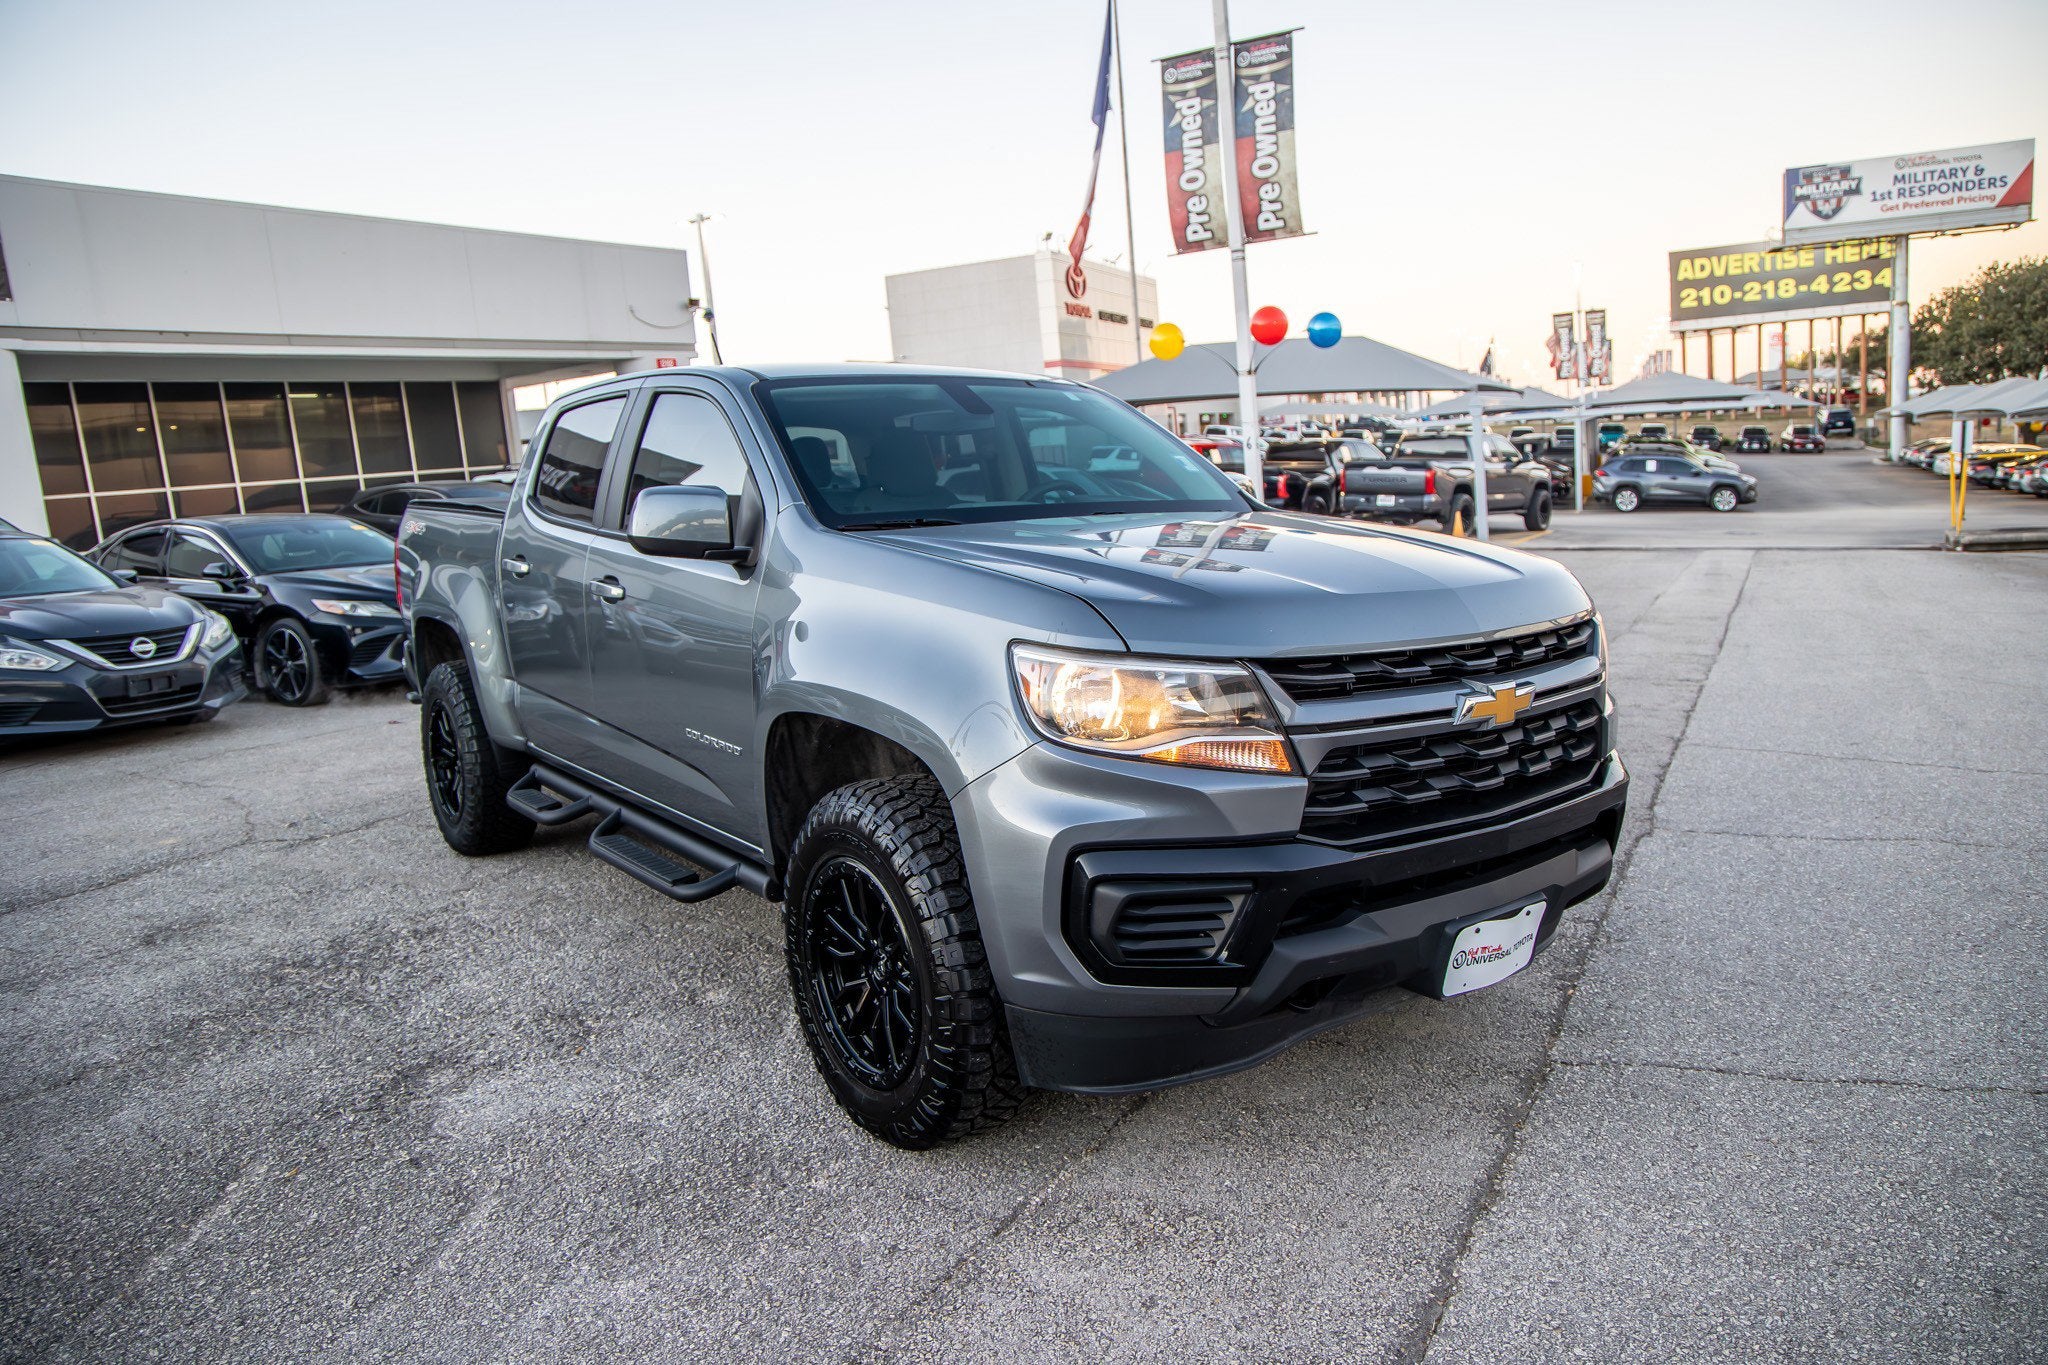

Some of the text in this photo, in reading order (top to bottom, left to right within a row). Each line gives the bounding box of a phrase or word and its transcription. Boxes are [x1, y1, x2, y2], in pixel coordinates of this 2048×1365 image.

[1174, 96, 1207, 192] Owned
[1247, 80, 1280, 179] Owned
[1795, 178, 1859, 197] MILITARY
[1871, 175, 2009, 202] 1st RESPONDERS
[1893, 164, 1985, 186] MILITARY &
[1185, 194, 1214, 244] Pre
[1257, 182, 1286, 232] Pre
[1880, 194, 1996, 212] Get Preferred Pricing
[1677, 245, 1815, 281] ADVERTISE
[1680, 267, 1892, 308] 210-218-4234
[685, 727, 743, 756] COLORADO
[1466, 933, 1534, 966] UNIVERSAL TOYOTA
